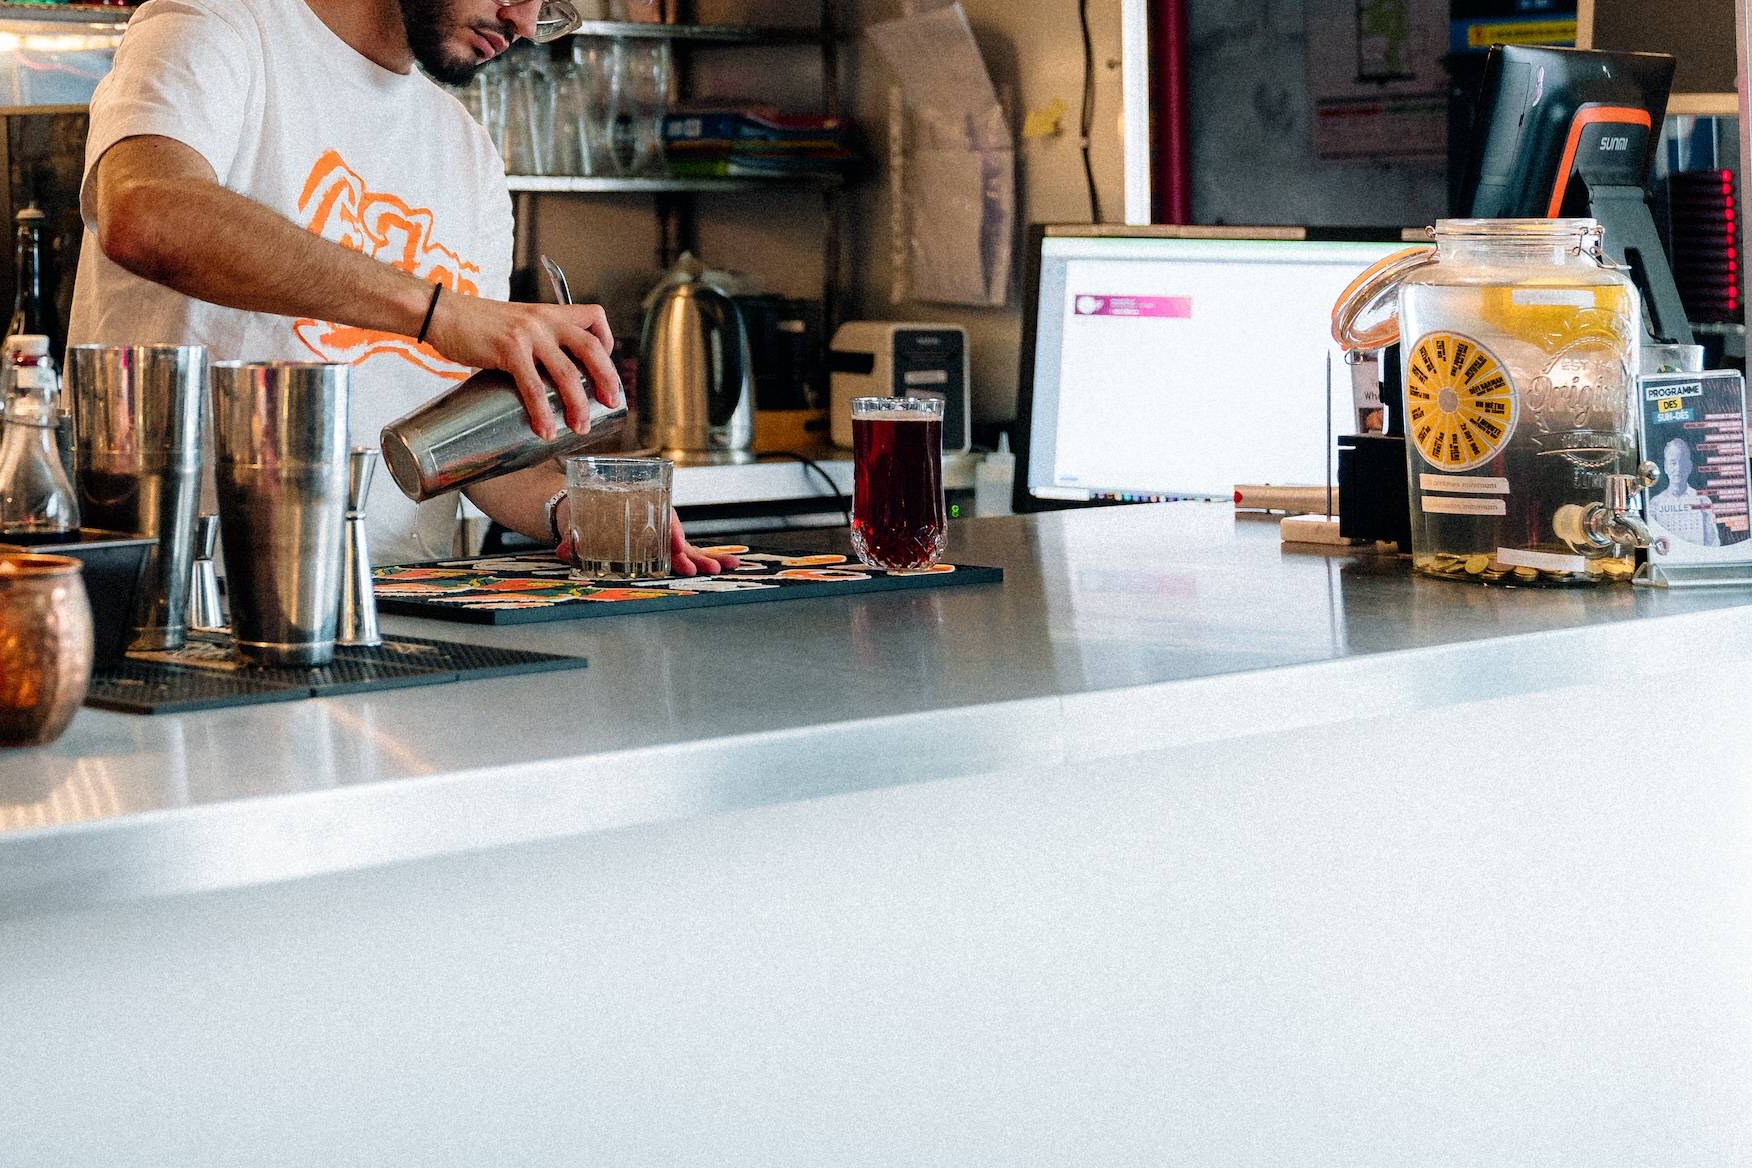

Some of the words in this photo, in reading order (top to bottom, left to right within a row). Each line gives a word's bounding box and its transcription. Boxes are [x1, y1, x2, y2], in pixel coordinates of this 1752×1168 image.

[1599, 136, 1629, 151] SUNMI
[1648, 384, 1700, 399] PROGRAMME
[1663, 399, 1678, 410] DES
